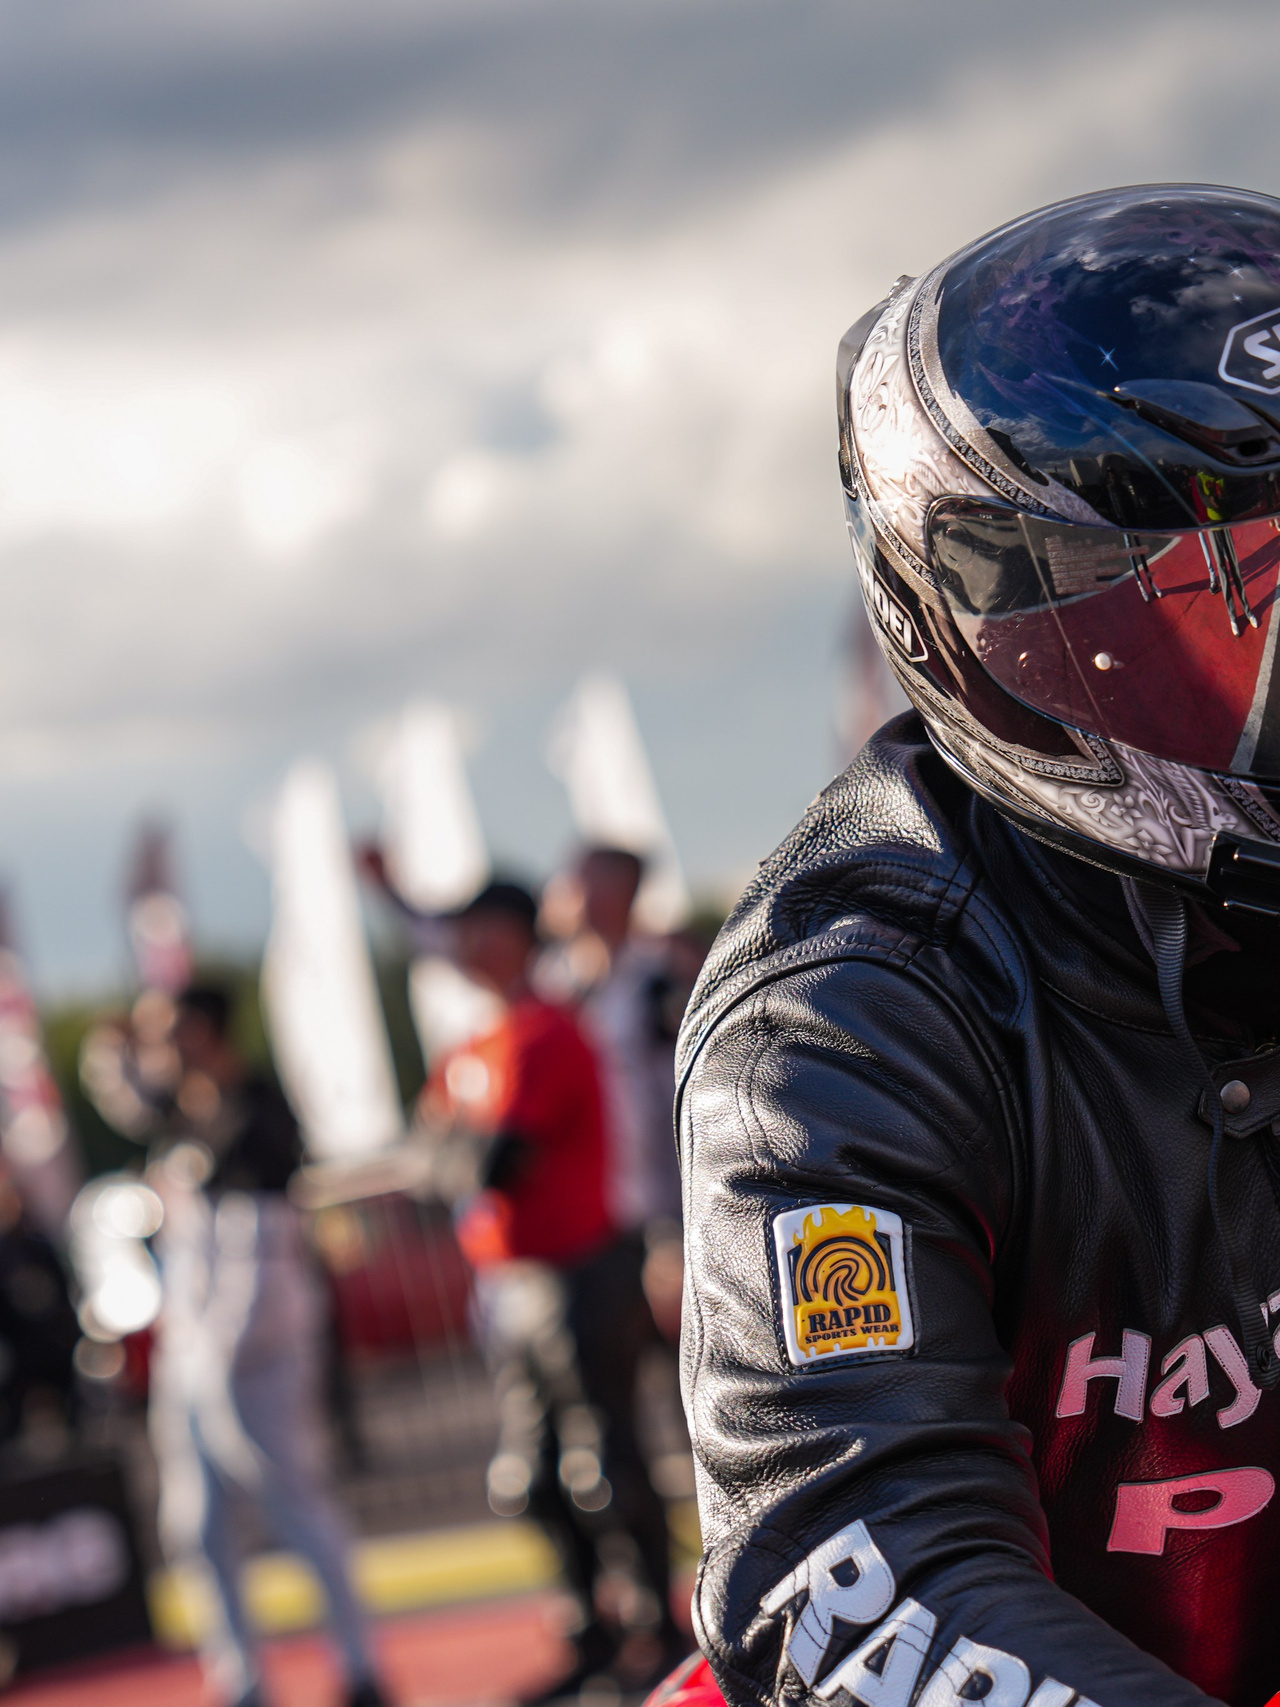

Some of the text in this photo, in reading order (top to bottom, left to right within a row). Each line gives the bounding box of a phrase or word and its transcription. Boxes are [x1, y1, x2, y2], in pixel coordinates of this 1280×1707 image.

[808, 1304, 891, 1333] RAPID
[805, 1323, 900, 1344] SPORTS WEAR
[760, 1518, 1105, 1707] RAP
